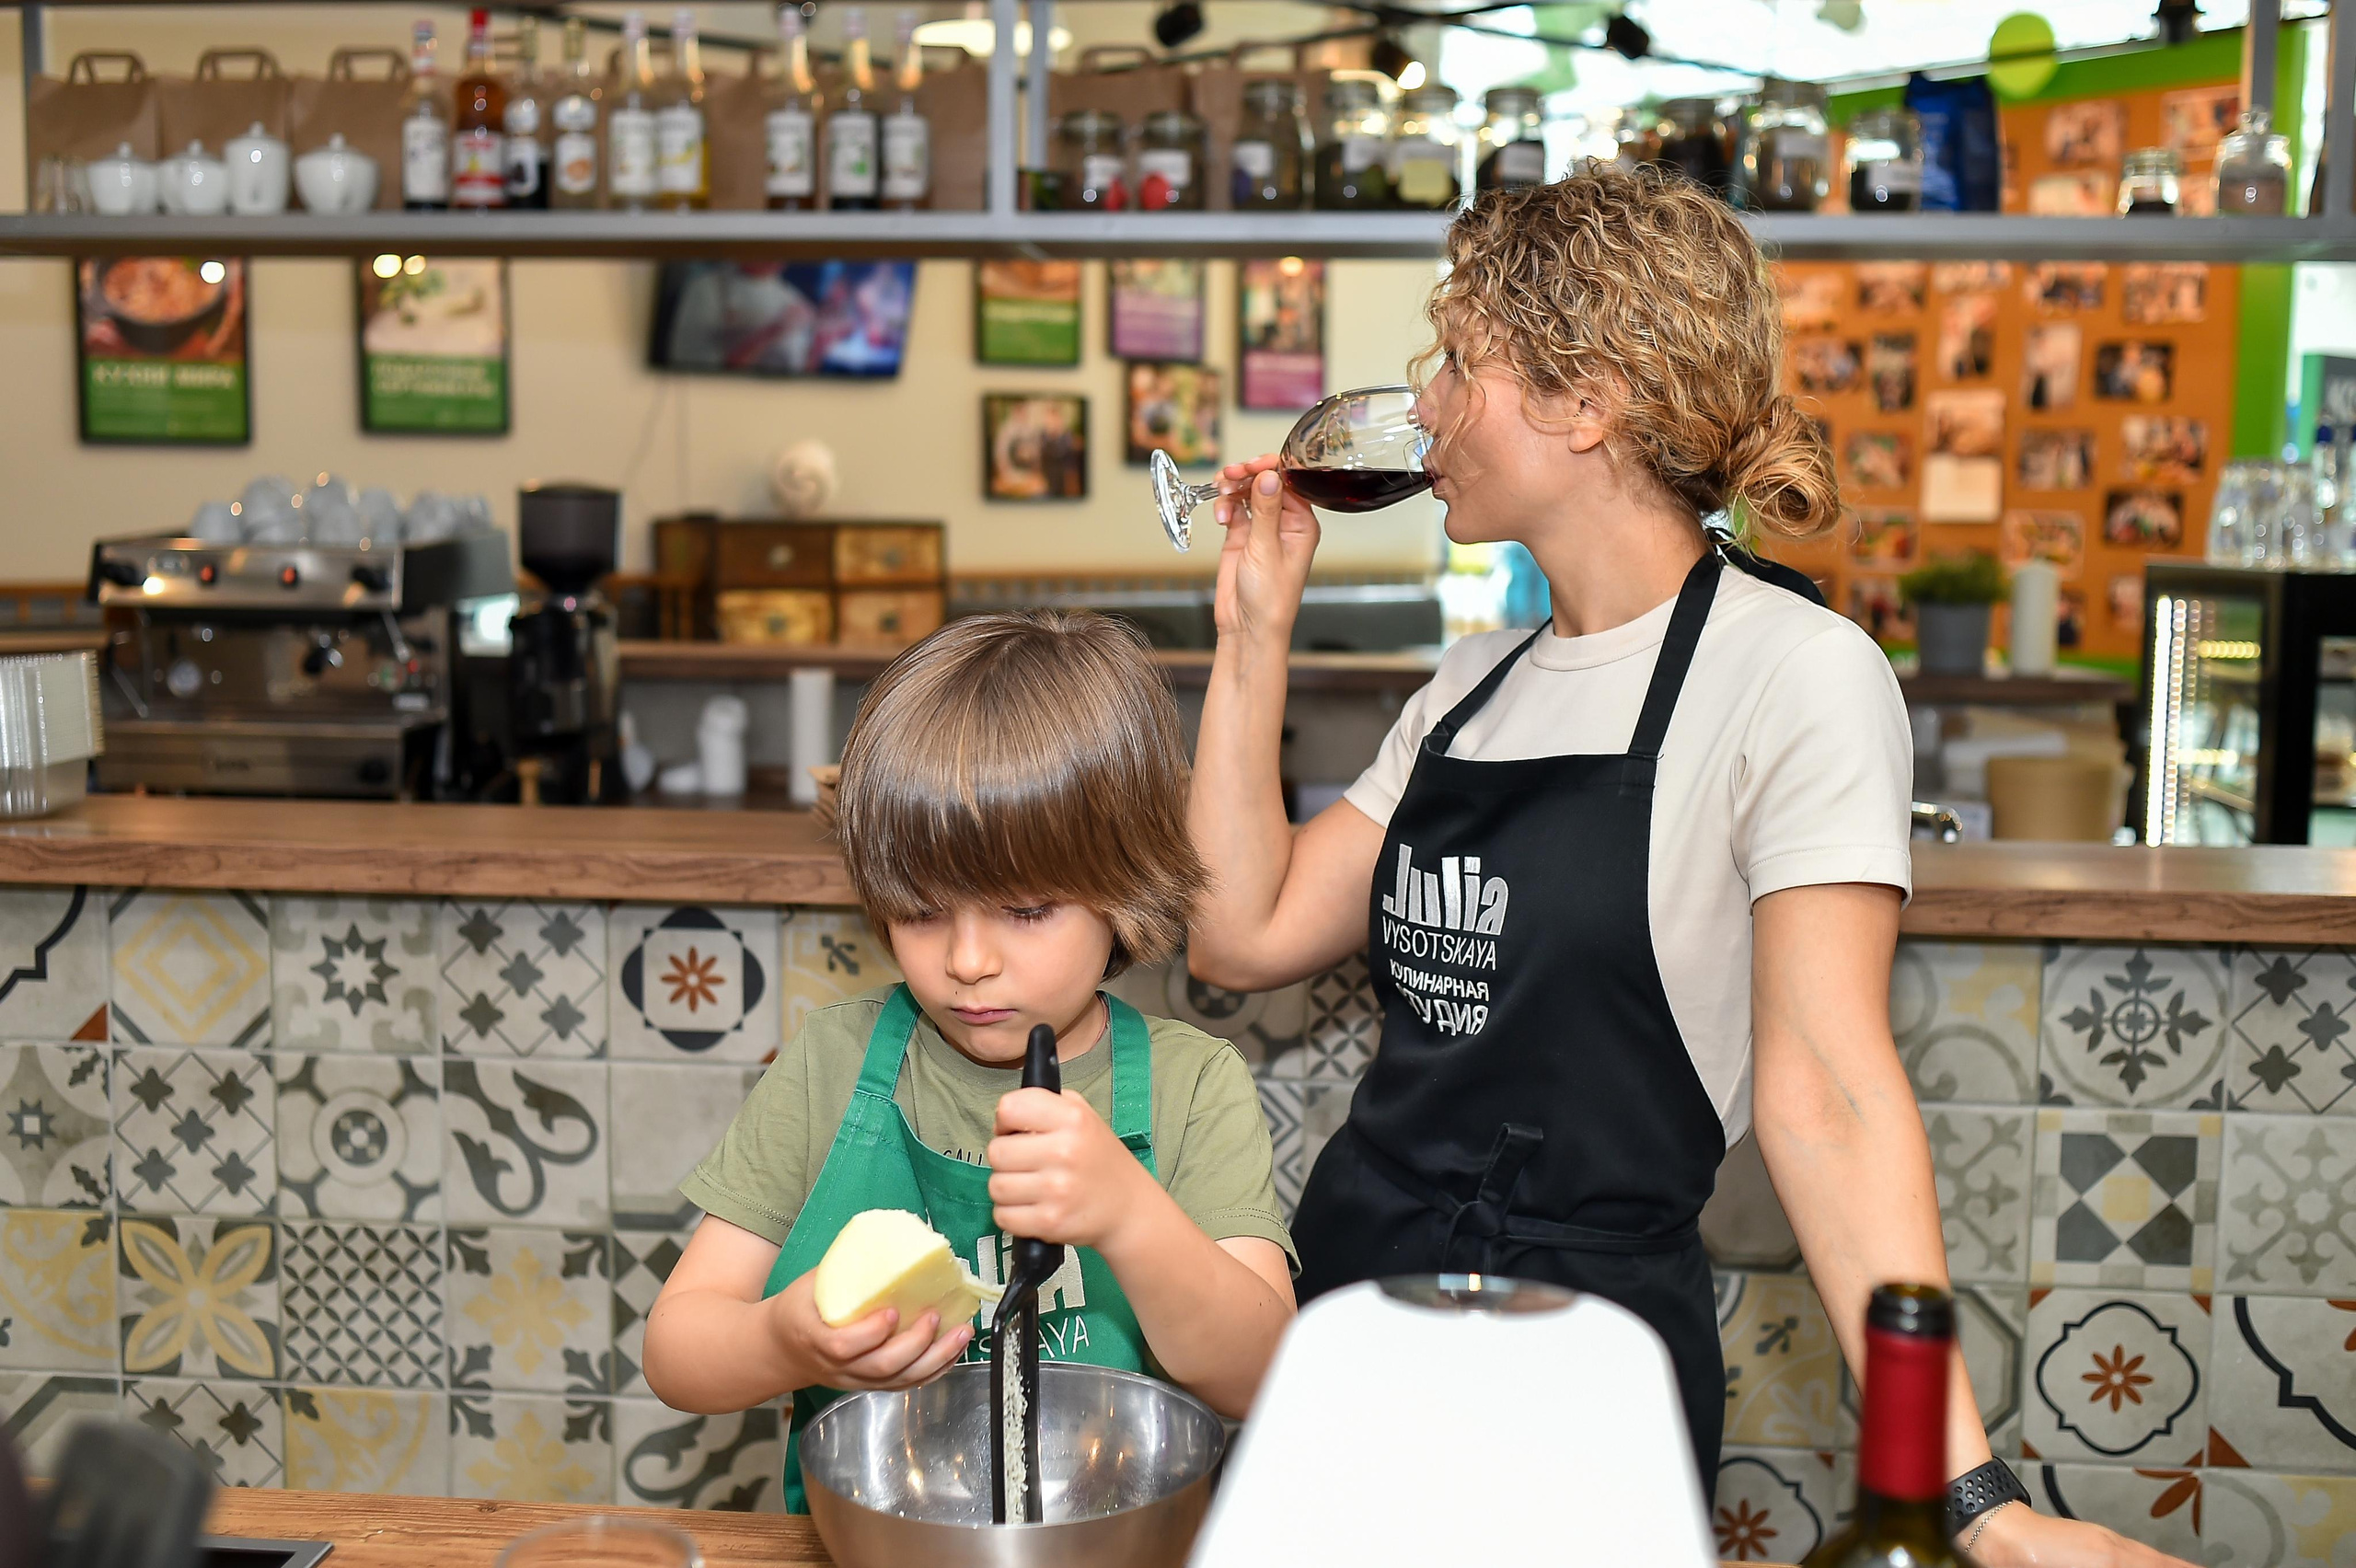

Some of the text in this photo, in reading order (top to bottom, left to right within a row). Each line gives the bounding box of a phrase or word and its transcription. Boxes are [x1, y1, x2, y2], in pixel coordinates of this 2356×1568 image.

[1382, 843, 1509, 936] Julia
[1382, 916, 1497, 971] VYSOTSKAYA
[1390, 959, 1490, 1002] КУЛИНАРНАЯ
